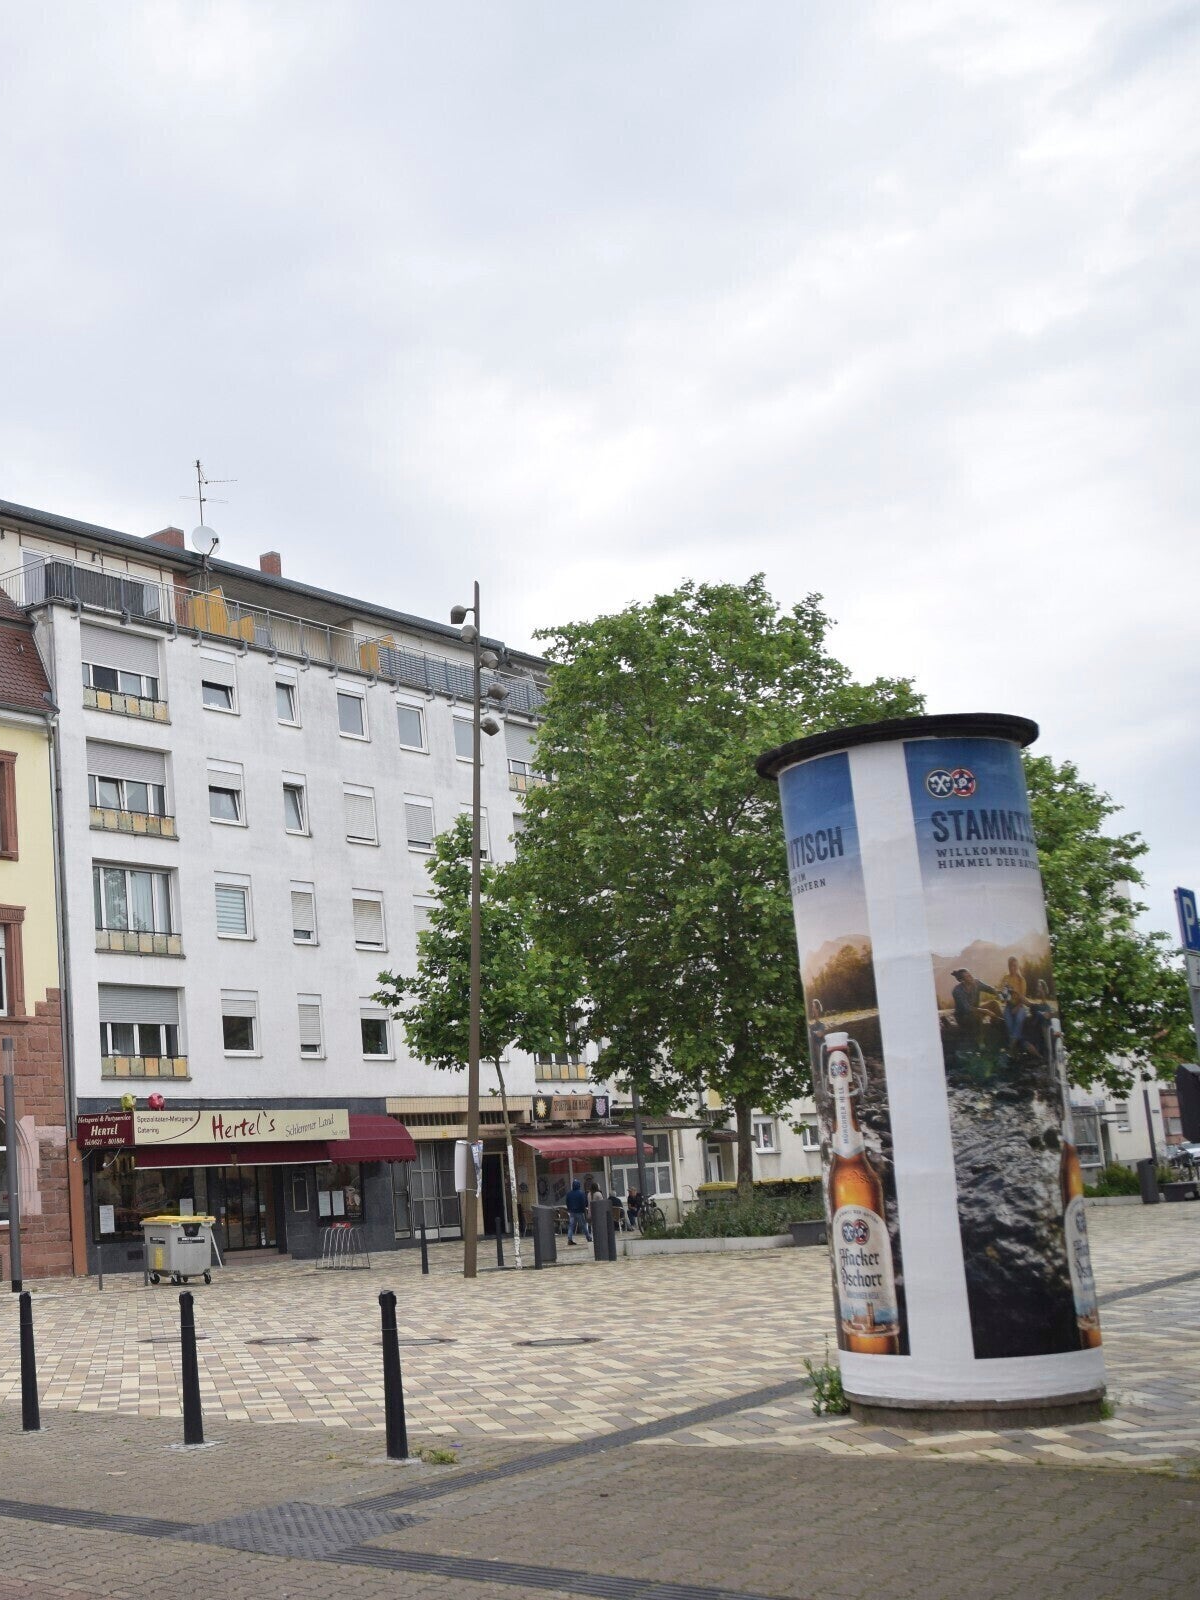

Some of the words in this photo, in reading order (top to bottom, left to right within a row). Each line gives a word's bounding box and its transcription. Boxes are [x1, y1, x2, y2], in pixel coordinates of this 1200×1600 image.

[936, 847, 1019, 858] WILLKOMMEN
[938, 858, 992, 868] HIMMEL
[997, 859, 1018, 867] DER
[1183, 896, 1196, 942] P
[318, 1113, 334, 1128] Land
